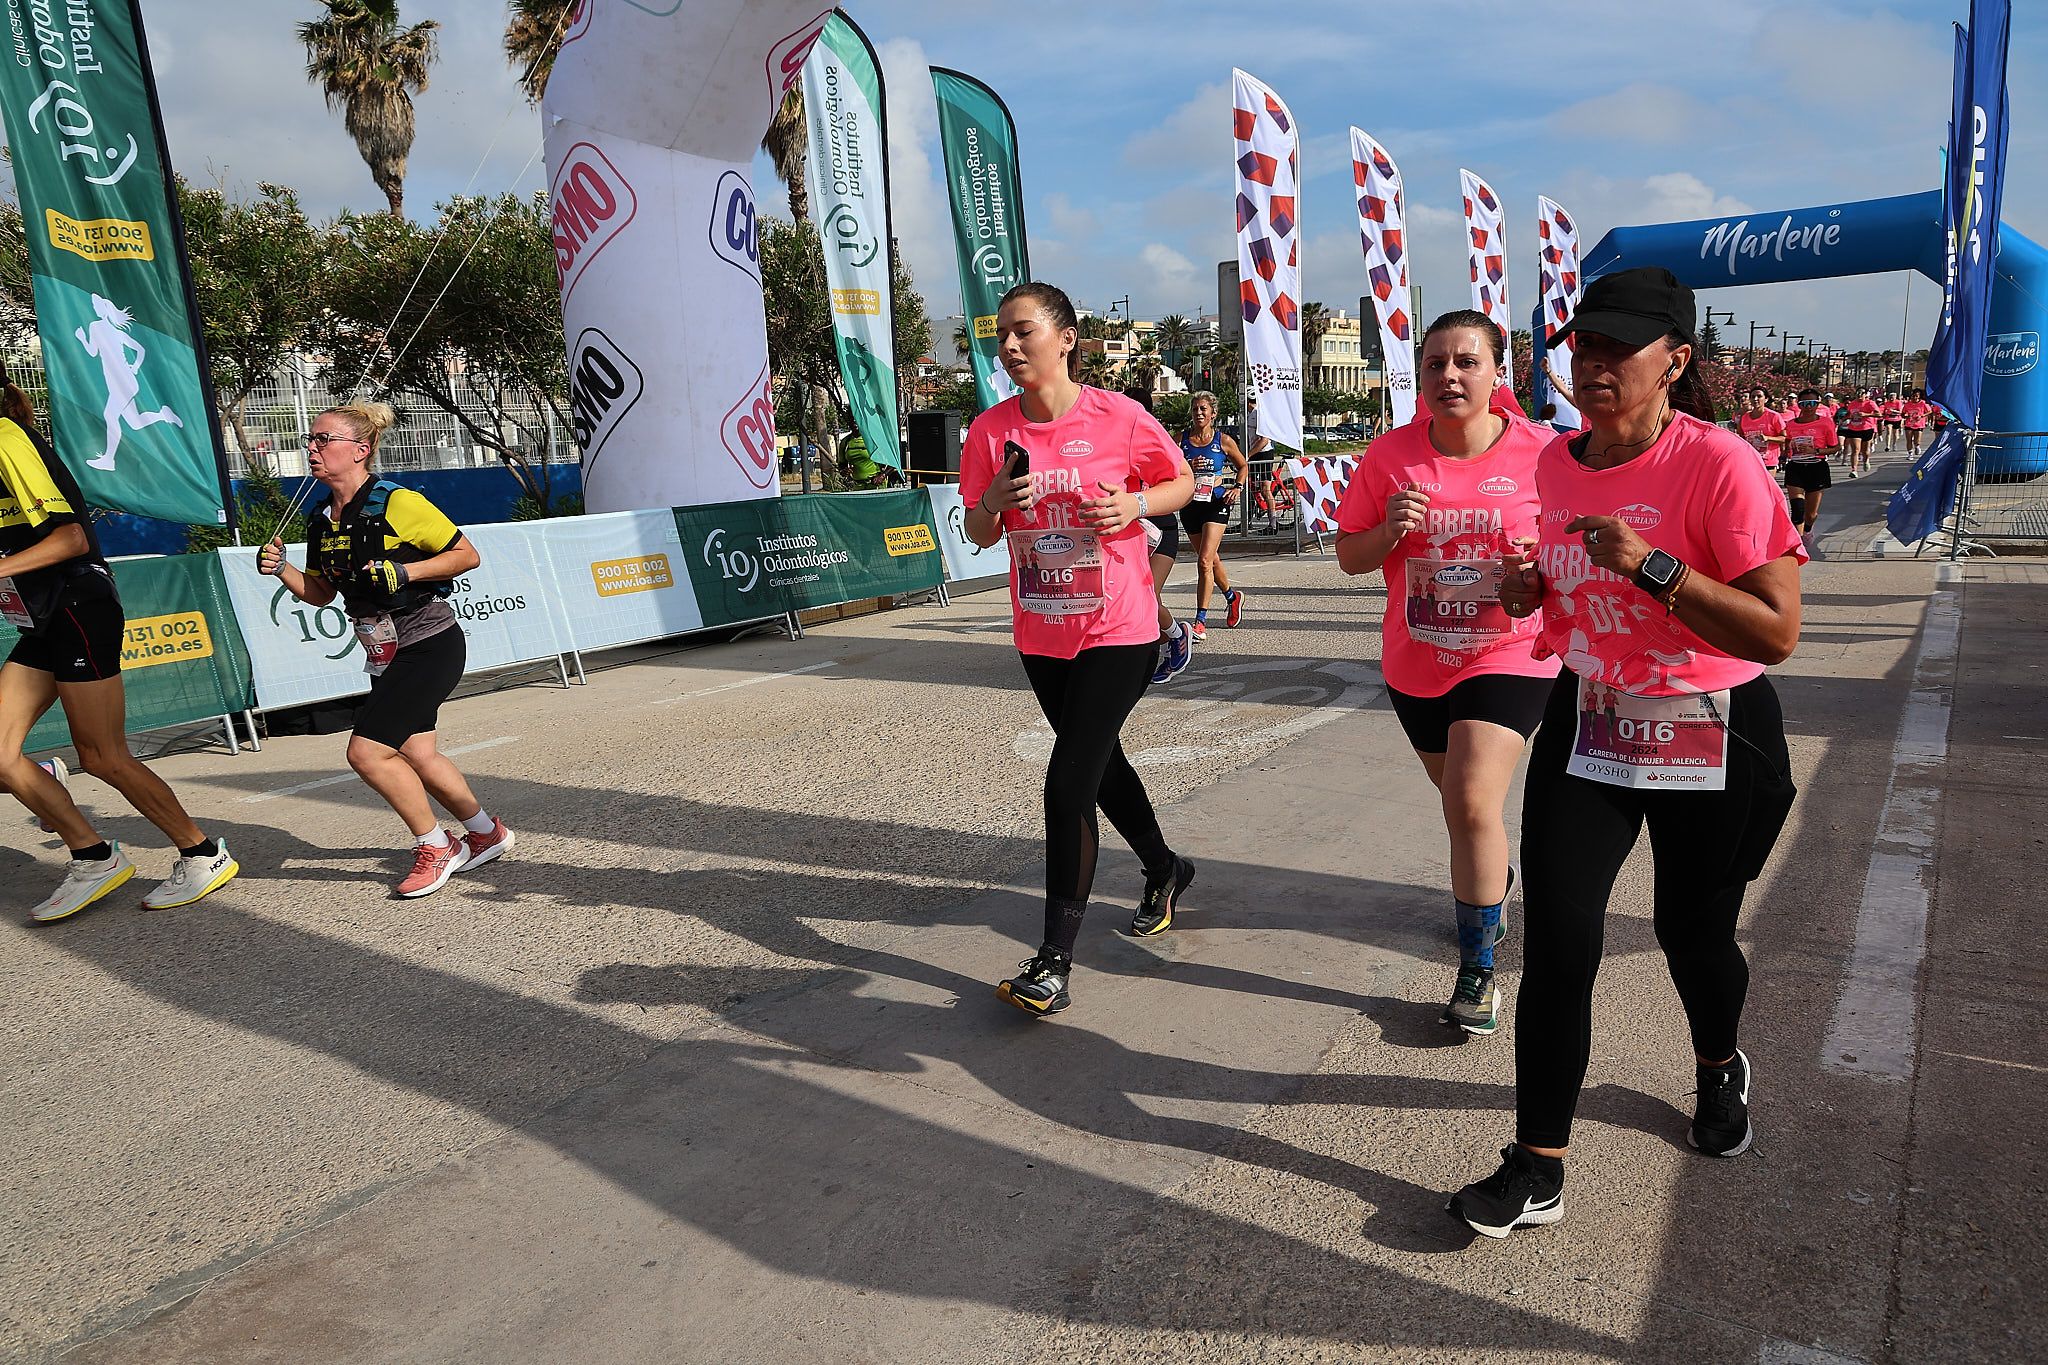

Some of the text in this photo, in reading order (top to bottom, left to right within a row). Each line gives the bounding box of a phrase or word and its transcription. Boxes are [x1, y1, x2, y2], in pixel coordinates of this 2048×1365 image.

[552, 161, 617, 292] SMO
[571, 345, 625, 470] SMO
[1030, 467, 1082, 496] RERA
[1480, 484, 1515, 492] ASTURIANA
[1413, 508, 1503, 534] ARRERA
[756, 533, 818, 553] Institutos
[888, 532, 901, 542] 900
[1036, 541, 1072, 550] ASTURIANA
[597, 560, 665, 579] 900 131 002
[763, 548, 849, 573] Odontológicos
[601, 573, 668, 591] www.ioa.es
[1041, 568, 1074, 583] 016
[1437, 573, 1479, 581] ASTURIANA
[453, 593, 527, 622] lógicos
[1437, 601, 1478, 616] 016
[1586, 594, 1631, 635] DE
[161, 620, 199, 638] 002
[120, 638, 203, 661] w.ioa.es
[1436, 650, 1463, 668] 2026
[1617, 718, 1675, 743] 016
[1588, 748, 1707, 765] CARRERA DE LA MUJER VALENCIA
[1631, 744, 1658, 755] 2624
[1586, 762, 1707, 783] OYSHO Santander
[209, 853, 228, 873] HOKA
